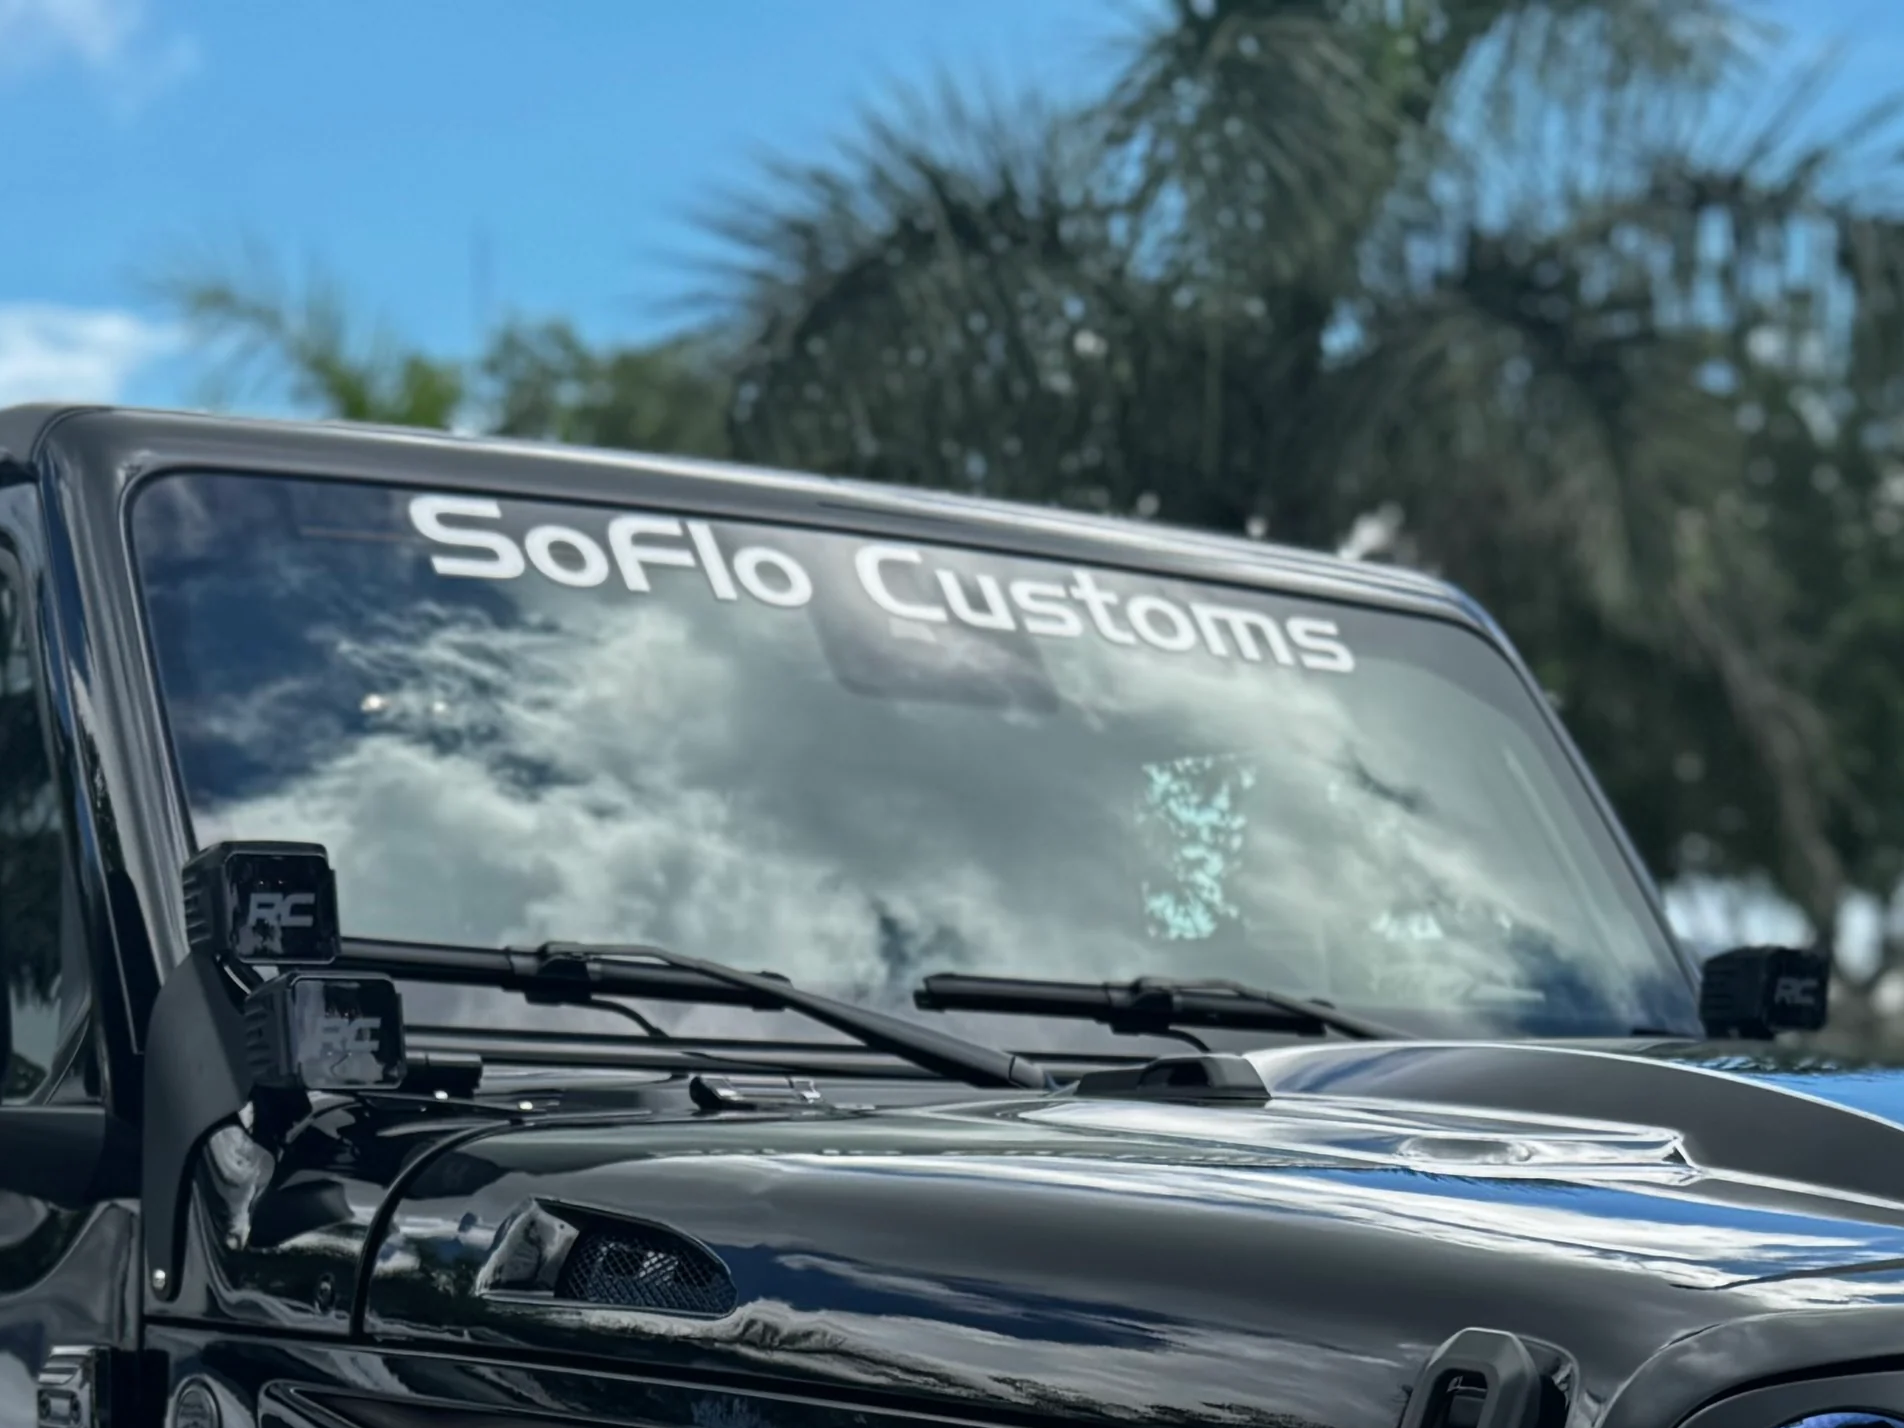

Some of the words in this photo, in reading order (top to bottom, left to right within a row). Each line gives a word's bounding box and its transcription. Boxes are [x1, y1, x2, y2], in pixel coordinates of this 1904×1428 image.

[408, 493, 814, 608] SoFlo
[855, 542, 1355, 674] Customs
[247, 892, 316, 929] RC
[1774, 976, 1819, 1006] RC
[318, 1016, 383, 1052] RC
